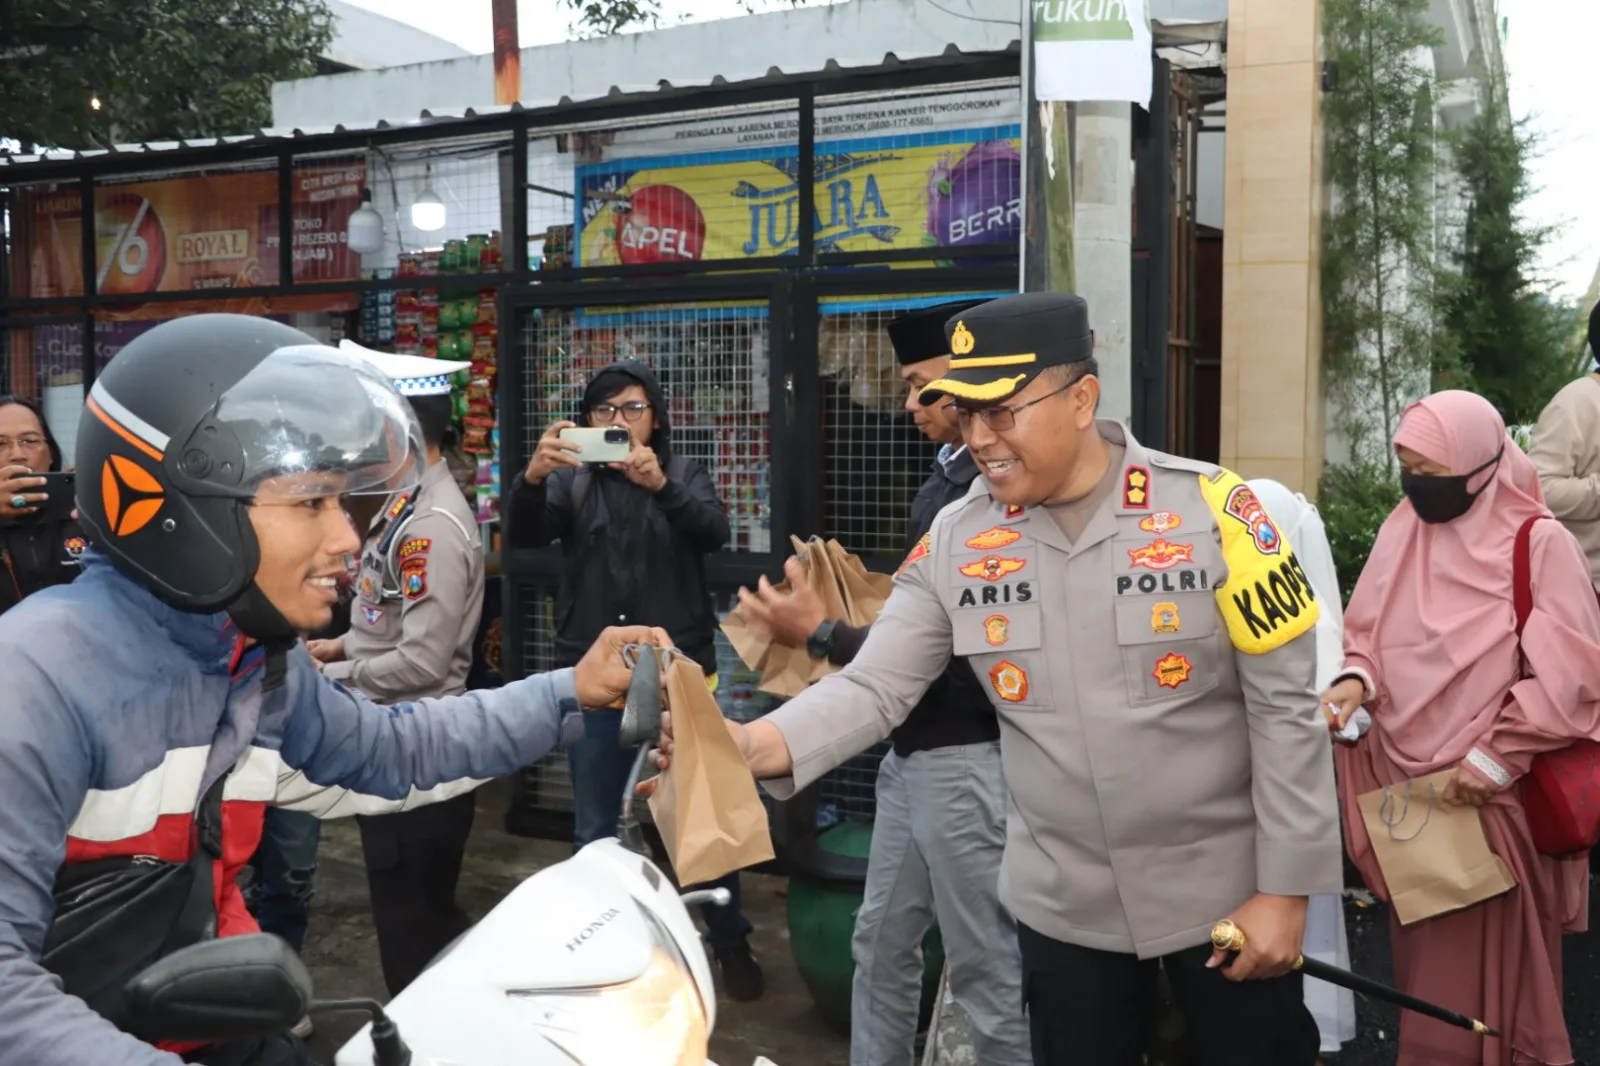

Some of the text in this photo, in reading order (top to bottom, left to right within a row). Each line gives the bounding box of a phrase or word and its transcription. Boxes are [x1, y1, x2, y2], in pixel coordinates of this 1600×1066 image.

[949, 199, 1021, 244] BERR
[182, 234, 243, 258] ROYAL
[620, 222, 694, 259] APEL
[48, 338, 83, 356] Cuc
[958, 581, 1033, 607] ARIS
[1116, 569, 1207, 595] POLRI
[565, 907, 622, 952] HONDA
